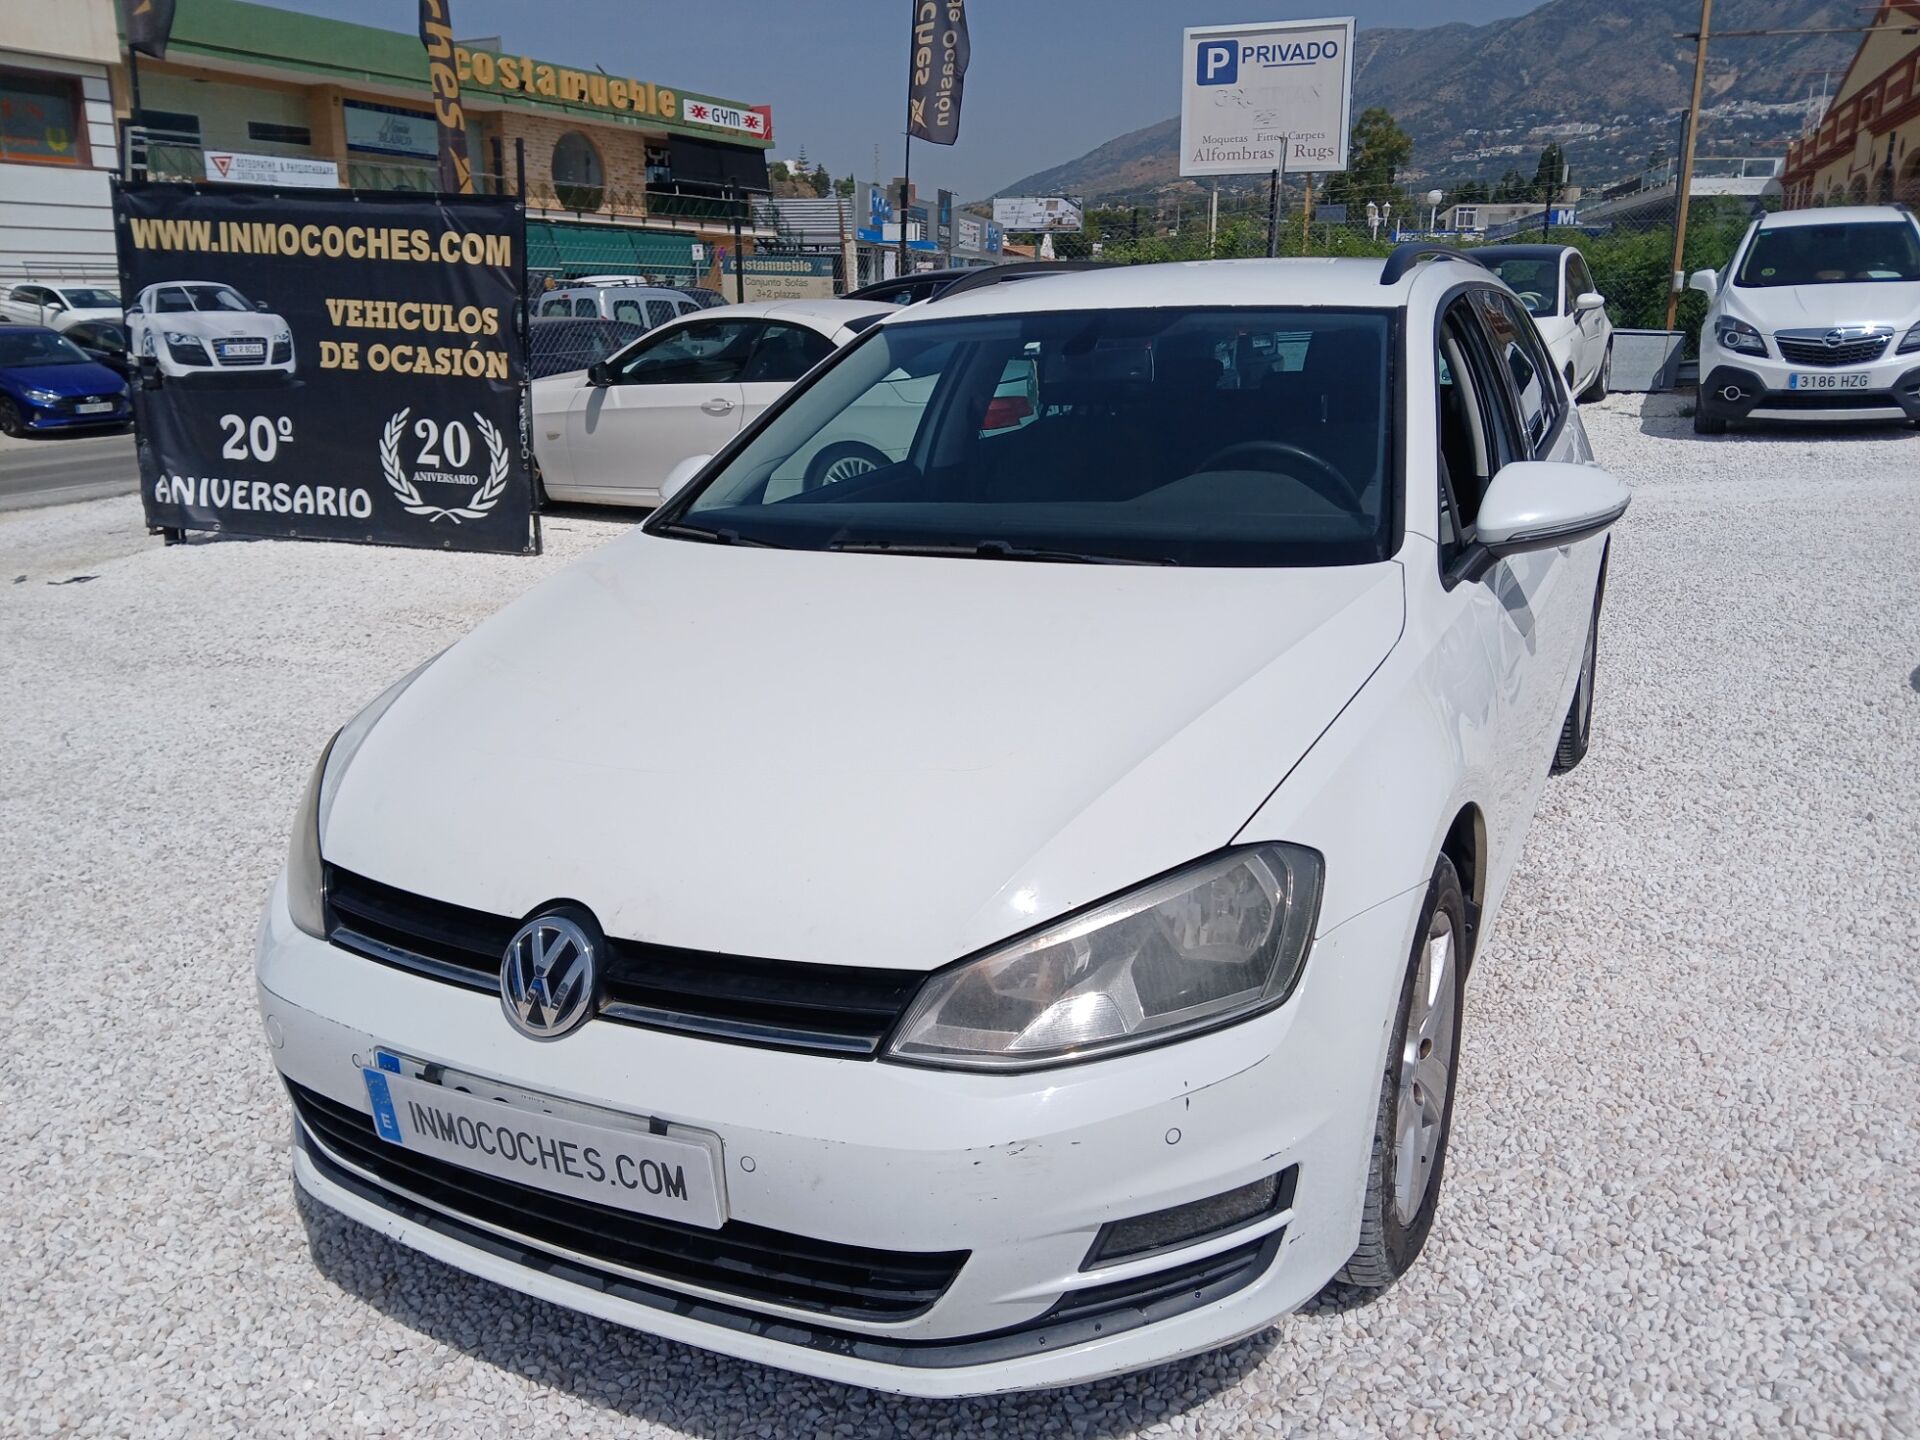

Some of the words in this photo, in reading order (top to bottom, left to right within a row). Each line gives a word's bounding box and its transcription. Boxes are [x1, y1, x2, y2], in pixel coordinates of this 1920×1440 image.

[1207, 47, 1231, 80] P
[1241, 40, 1338, 64] PRIVADO
[454, 47, 676, 118] costamueble
[711, 107, 741, 127] GYM
[1192, 145, 1275, 162] Alfombras
[1294, 143, 1335, 162] Rugs
[1202, 133, 1248, 146] Moquetas
[1288, 130, 1326, 143] Carpets
[130, 217, 511, 268] WWW.INMOCOCHES.COM
[730, 260, 812, 273] cstamueble
[744, 277, 782, 288] Conjunto
[756, 289, 772, 298] 3+2
[774, 290, 801, 299] plazas
[325, 298, 498, 336] VEHICULOS
[319, 341, 359, 370] DE
[367, 340, 509, 380] OCASIÓN
[1800, 375, 1836, 388] 3186
[1840, 375, 1868, 387] HZG
[414, 418, 471, 469] 20
[412, 471, 478, 486] ANIVERSARIO
[154, 474, 372, 519] ANIVERSARIO
[381, 1113, 393, 1129] E
[407, 1100, 688, 1202] INMOCOCHES.COM
